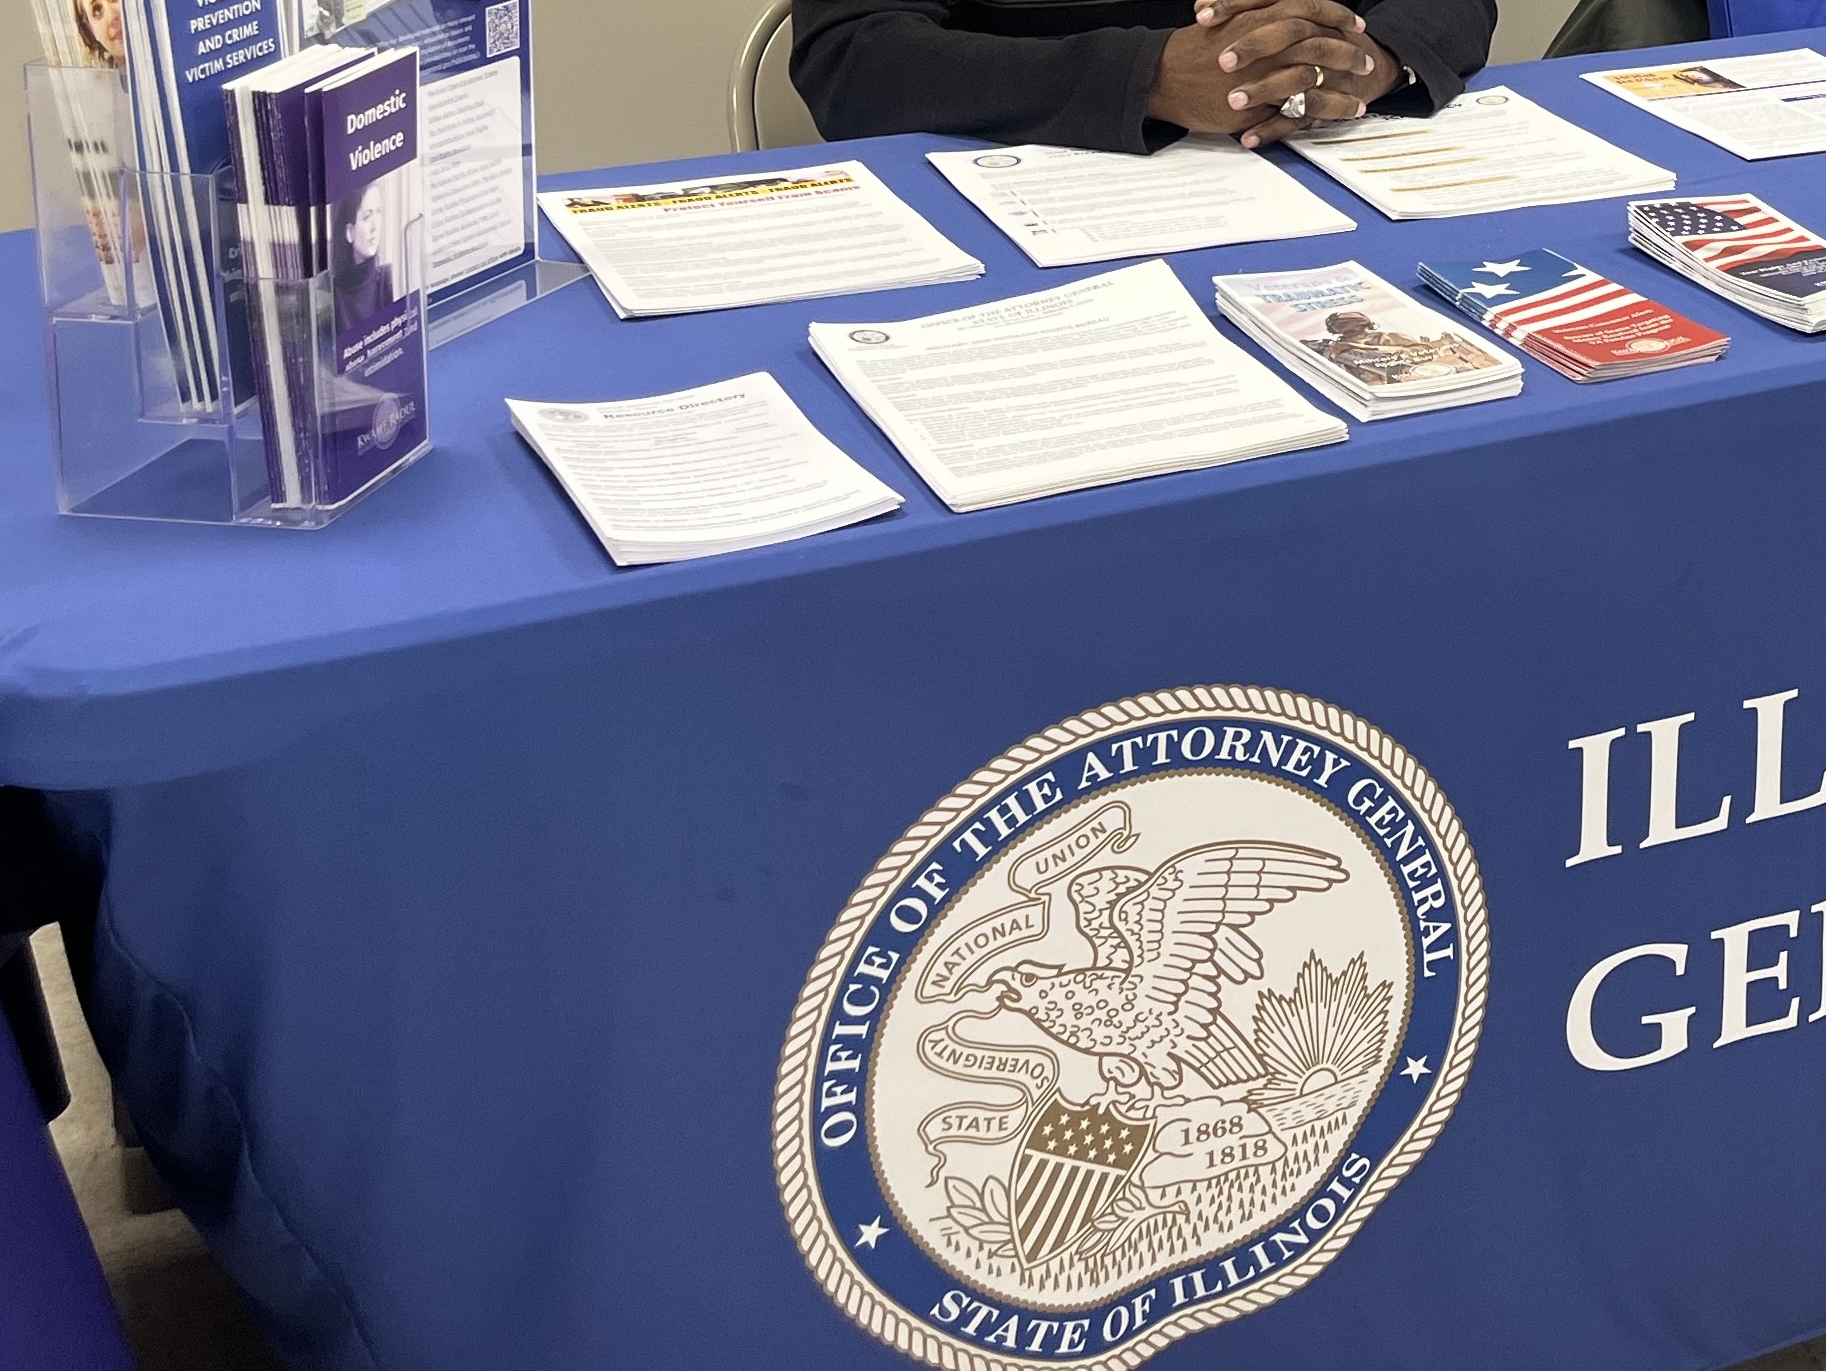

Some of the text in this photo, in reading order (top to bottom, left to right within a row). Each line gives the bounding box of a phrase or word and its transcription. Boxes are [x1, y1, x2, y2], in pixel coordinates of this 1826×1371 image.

[185, 38, 275, 84] VICTIM SERVICES
[198, 21, 259, 56] AND CRIME
[346, 90, 407, 135] Domestic
[348, 128, 404, 171] Violence
[603, 392, 746, 419] Resource Directory
[1035, 820, 1108, 875] UNION
[820, 726, 1455, 1148] OFFICE OF THE ATTORNEY GENERAL
[930, 913, 1036, 990] NATIONAL
[926, 1034, 1046, 1091] SOVEREIGNTY
[941, 1113, 1010, 1134] STATE
[1180, 1114, 1246, 1148] 1868
[1204, 1136, 1269, 1170] 1818
[930, 1151, 1373, 1355] STATE OF ILLINOIS
